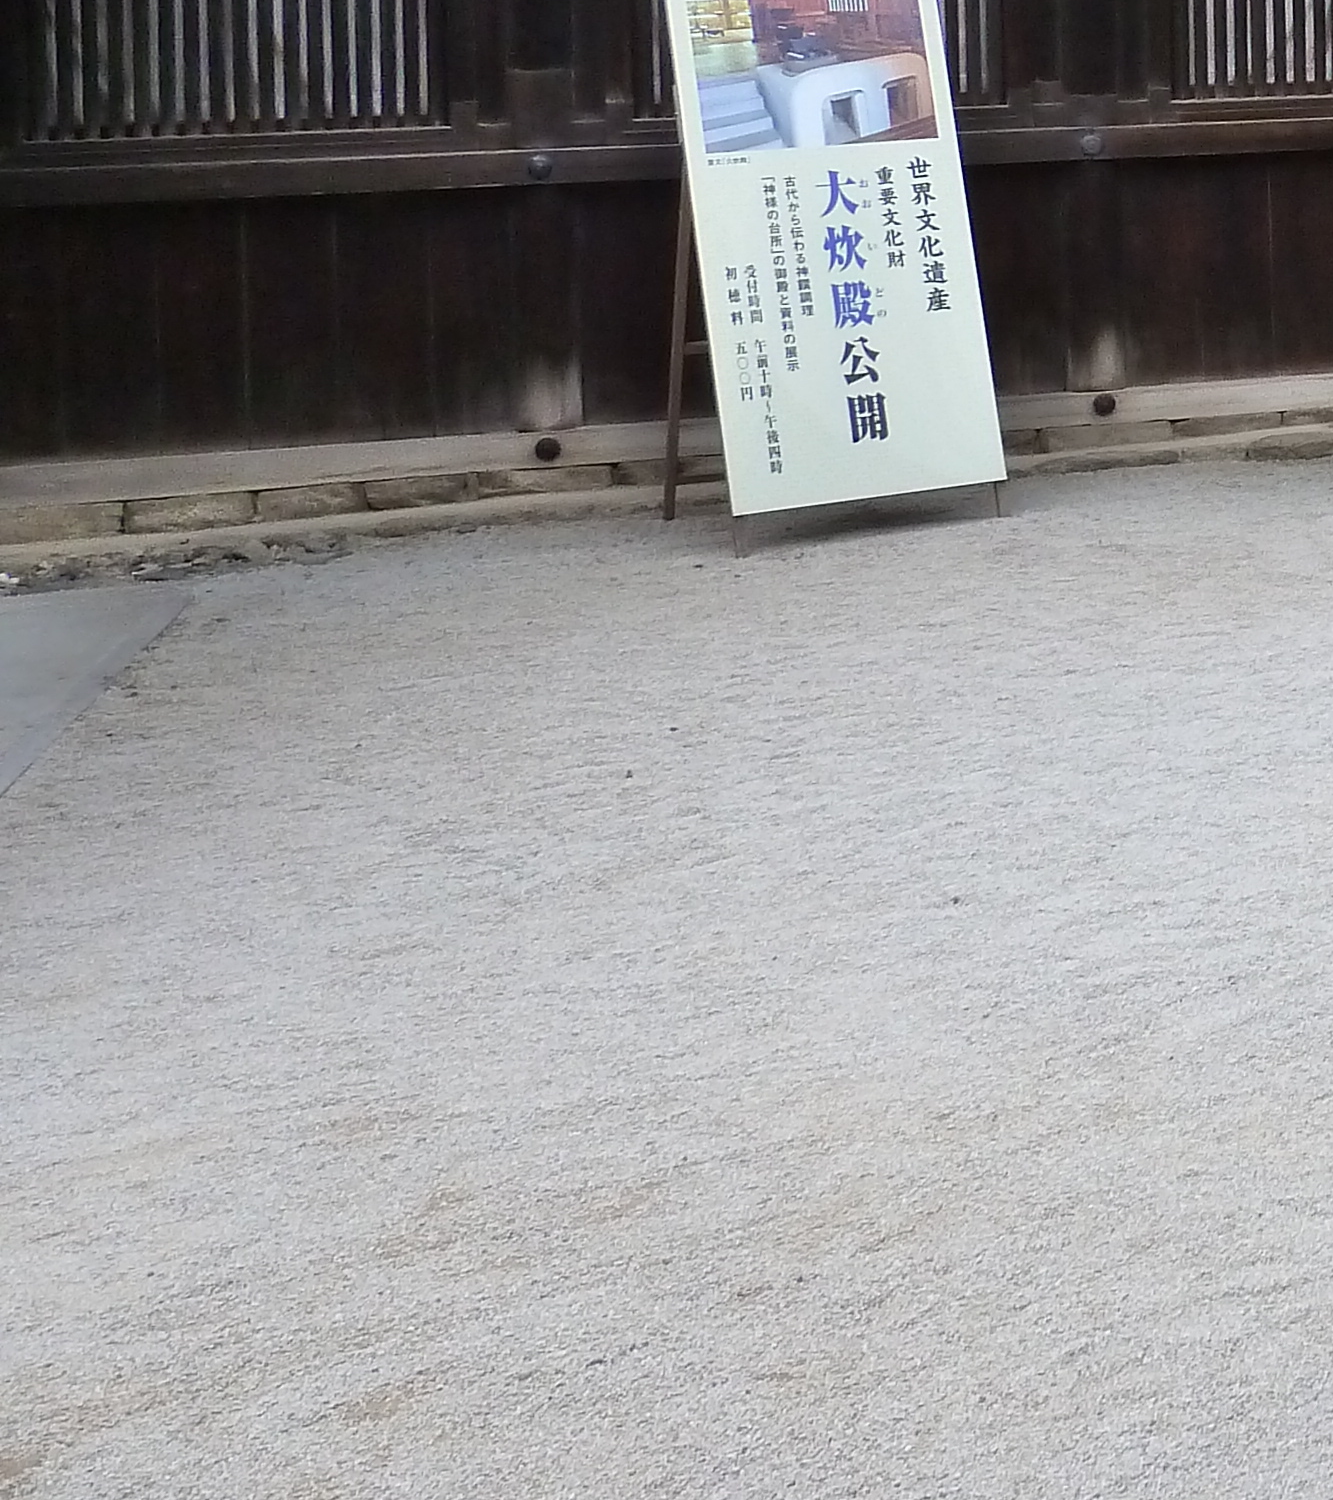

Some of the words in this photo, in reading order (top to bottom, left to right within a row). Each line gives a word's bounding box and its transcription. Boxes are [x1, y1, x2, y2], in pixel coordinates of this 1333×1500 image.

[875, 166, 906, 268] 重要文化財
[906, 156, 952, 312] 世界文化遺産
[743, 264, 763, 324] 受付時間
[815, 170, 890, 444] 大炊殿公開
